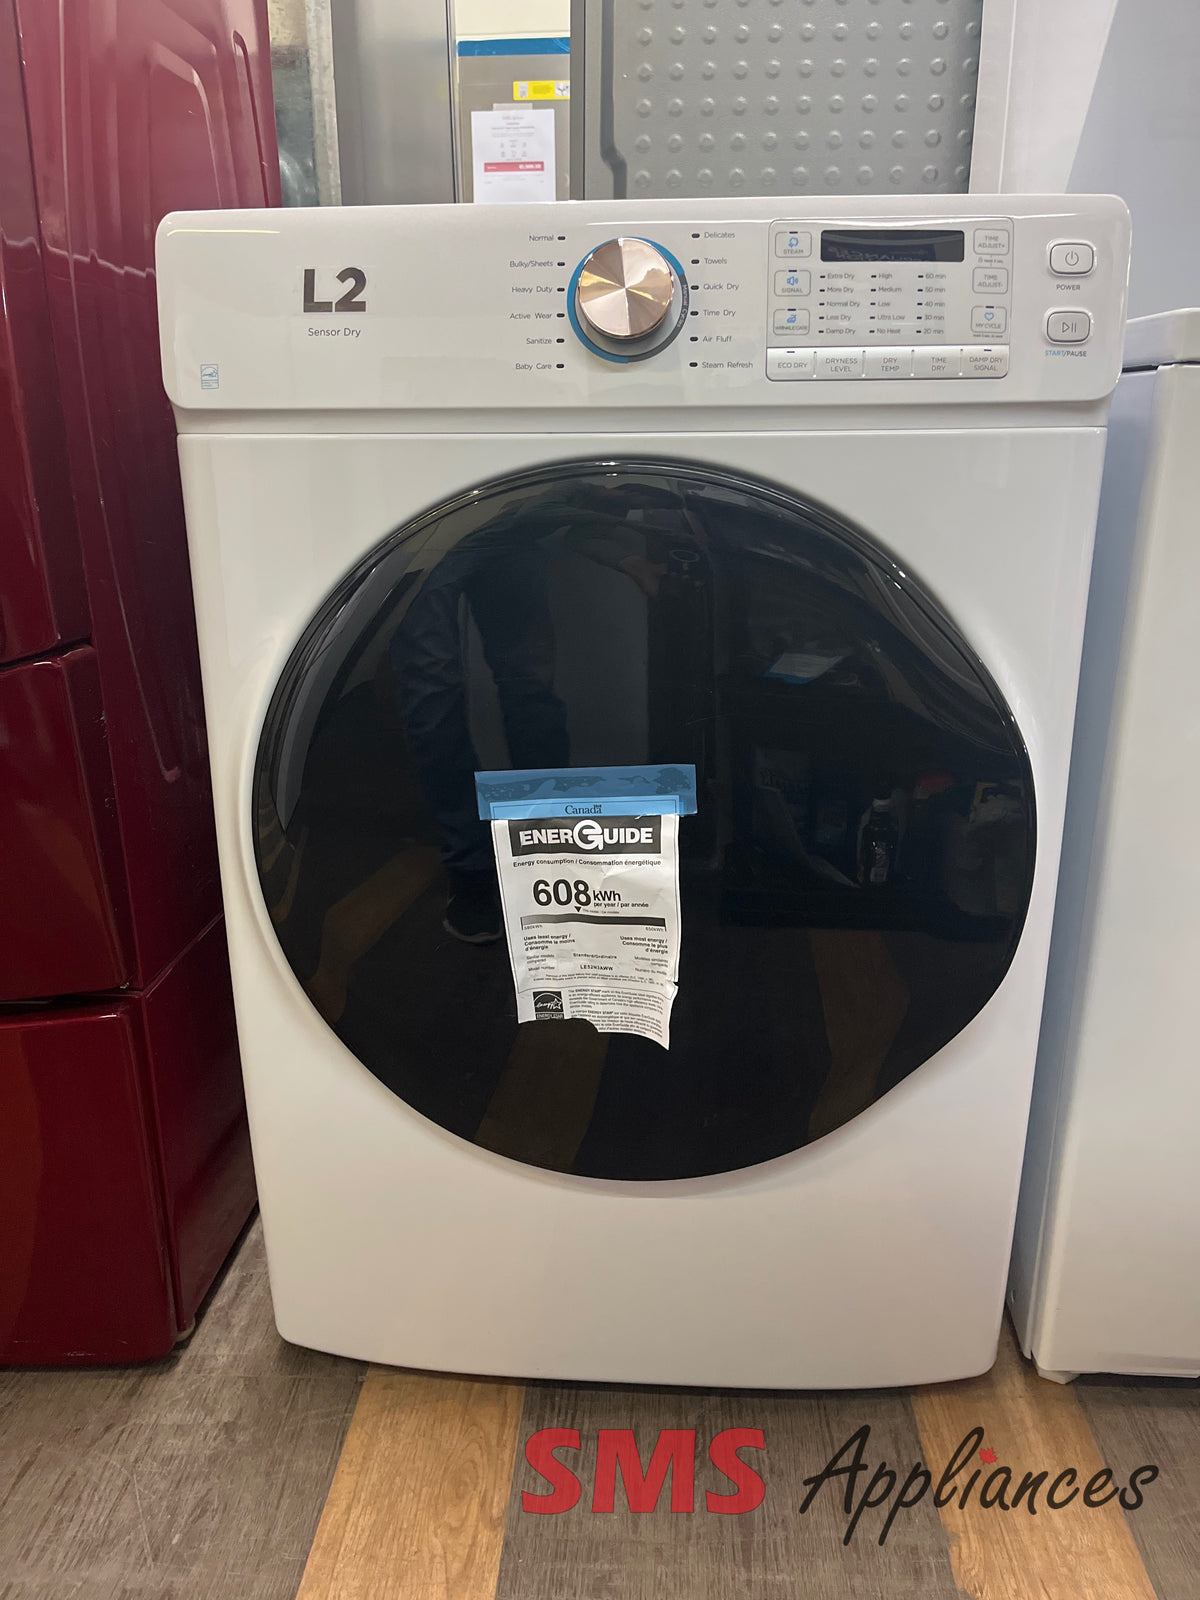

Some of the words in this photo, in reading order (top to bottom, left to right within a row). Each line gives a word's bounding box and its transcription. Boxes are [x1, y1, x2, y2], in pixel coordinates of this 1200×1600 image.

[704, 231, 735, 239] Delicates
[509, 260, 553, 268] Bulky/Sheets
[303, 267, 367, 313] L2
[512, 286, 534, 294] Heavy
[537, 286, 552, 294] Duty
[725, 283, 739, 292] Dry
[724, 309, 736, 318] Dry
[308, 328, 340, 337] Sensor
[343, 328, 361, 338] Dry
[515, 363, 534, 371] Baby
[727, 361, 753, 369] Refresh
[564, 804, 602, 815] Canada
[520, 819, 653, 850] ENERGUIDE
[533, 878, 591, 907] 608
[593, 890, 621, 901] kWh
